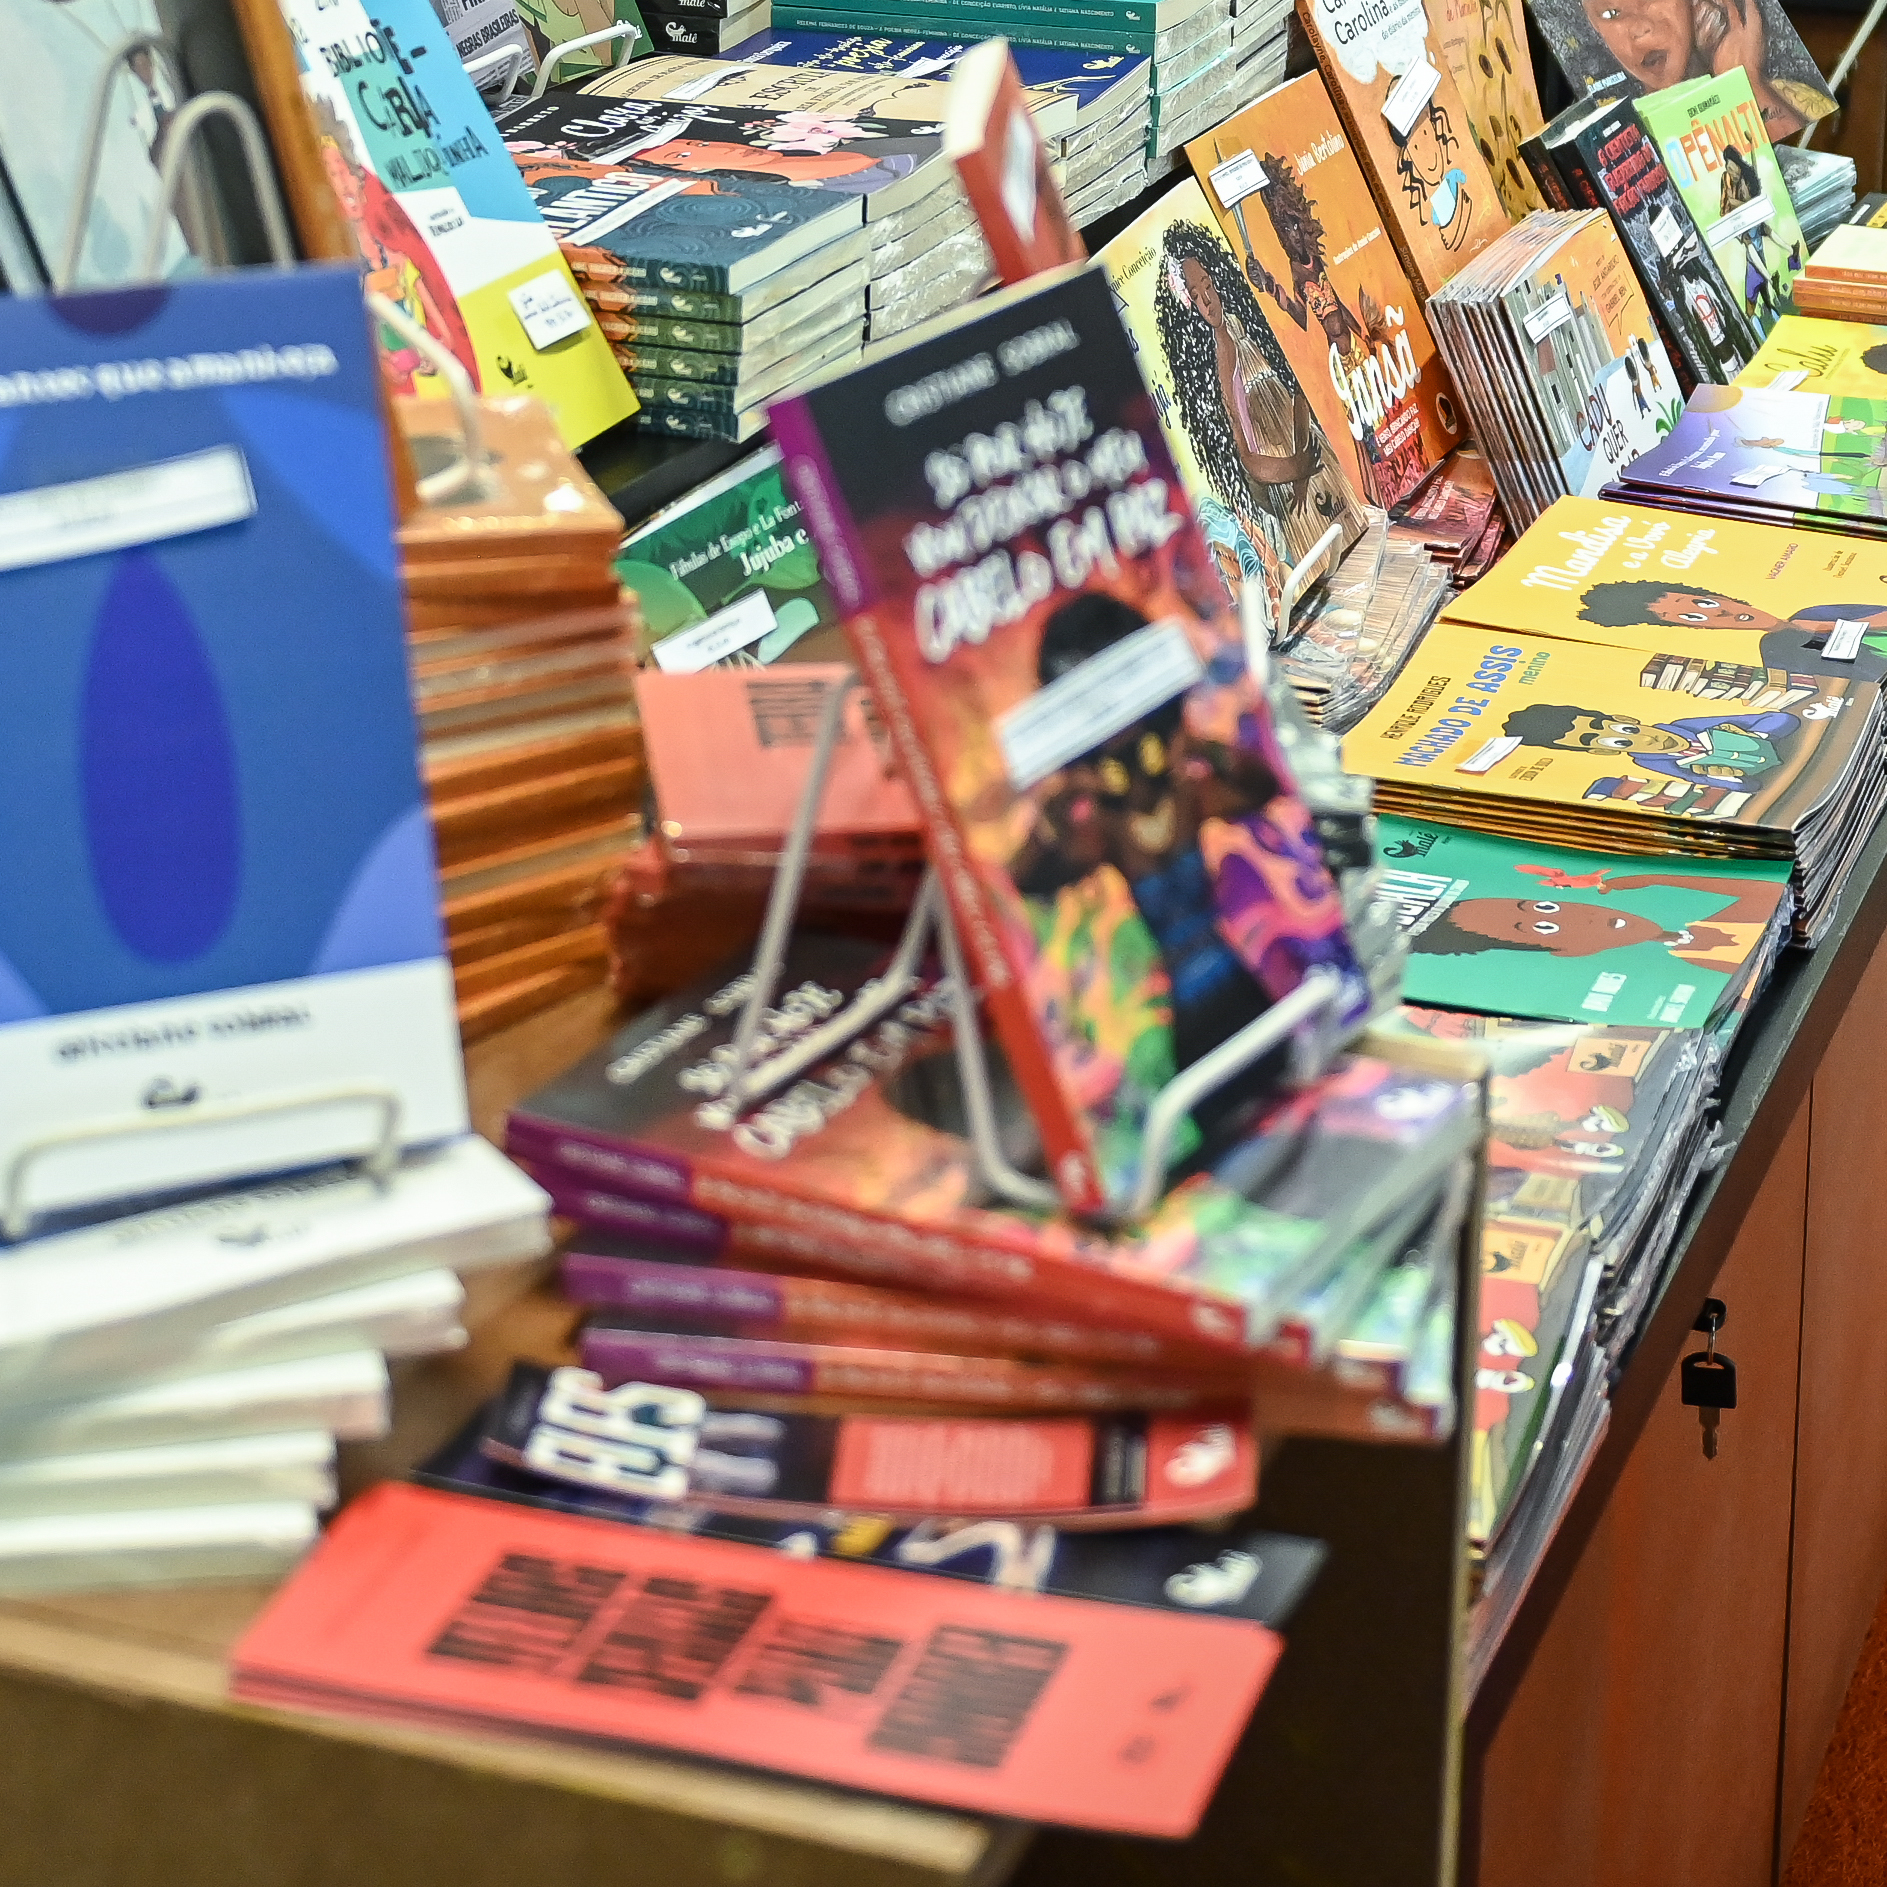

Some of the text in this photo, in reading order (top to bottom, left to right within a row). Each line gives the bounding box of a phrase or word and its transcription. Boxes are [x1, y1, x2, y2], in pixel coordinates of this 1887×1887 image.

[960, 0, 992, 10] CONCEIÇÃO
[1031, 2, 1054, 13] NATÁLIA
[1080, 9, 1115, 18] NASCIMENTO
[455, 8, 521, 58] NEGRAS BRASILEIRAS
[671, 32, 698, 44] malê
[1302, 10, 1345, 106] Carolayne, Carolina
[1665, 98, 1770, 189] O PÊNALTI
[1576, 381, 1613, 453] CADU
[1602, 418, 1630, 464] QUER
[757, 512, 777, 532] La
[739, 532, 796, 578] Jujuba
[1520, 513, 1633, 592] Mandisa
[1660, 526, 1721, 570] Alegria
[1517, 650, 1552, 686] menino
[1392, 644, 1523, 768] MACHADO DE ASSIS
[1407, 674, 1452, 715] RODRIGUES
[1419, 830, 1440, 859] malê
